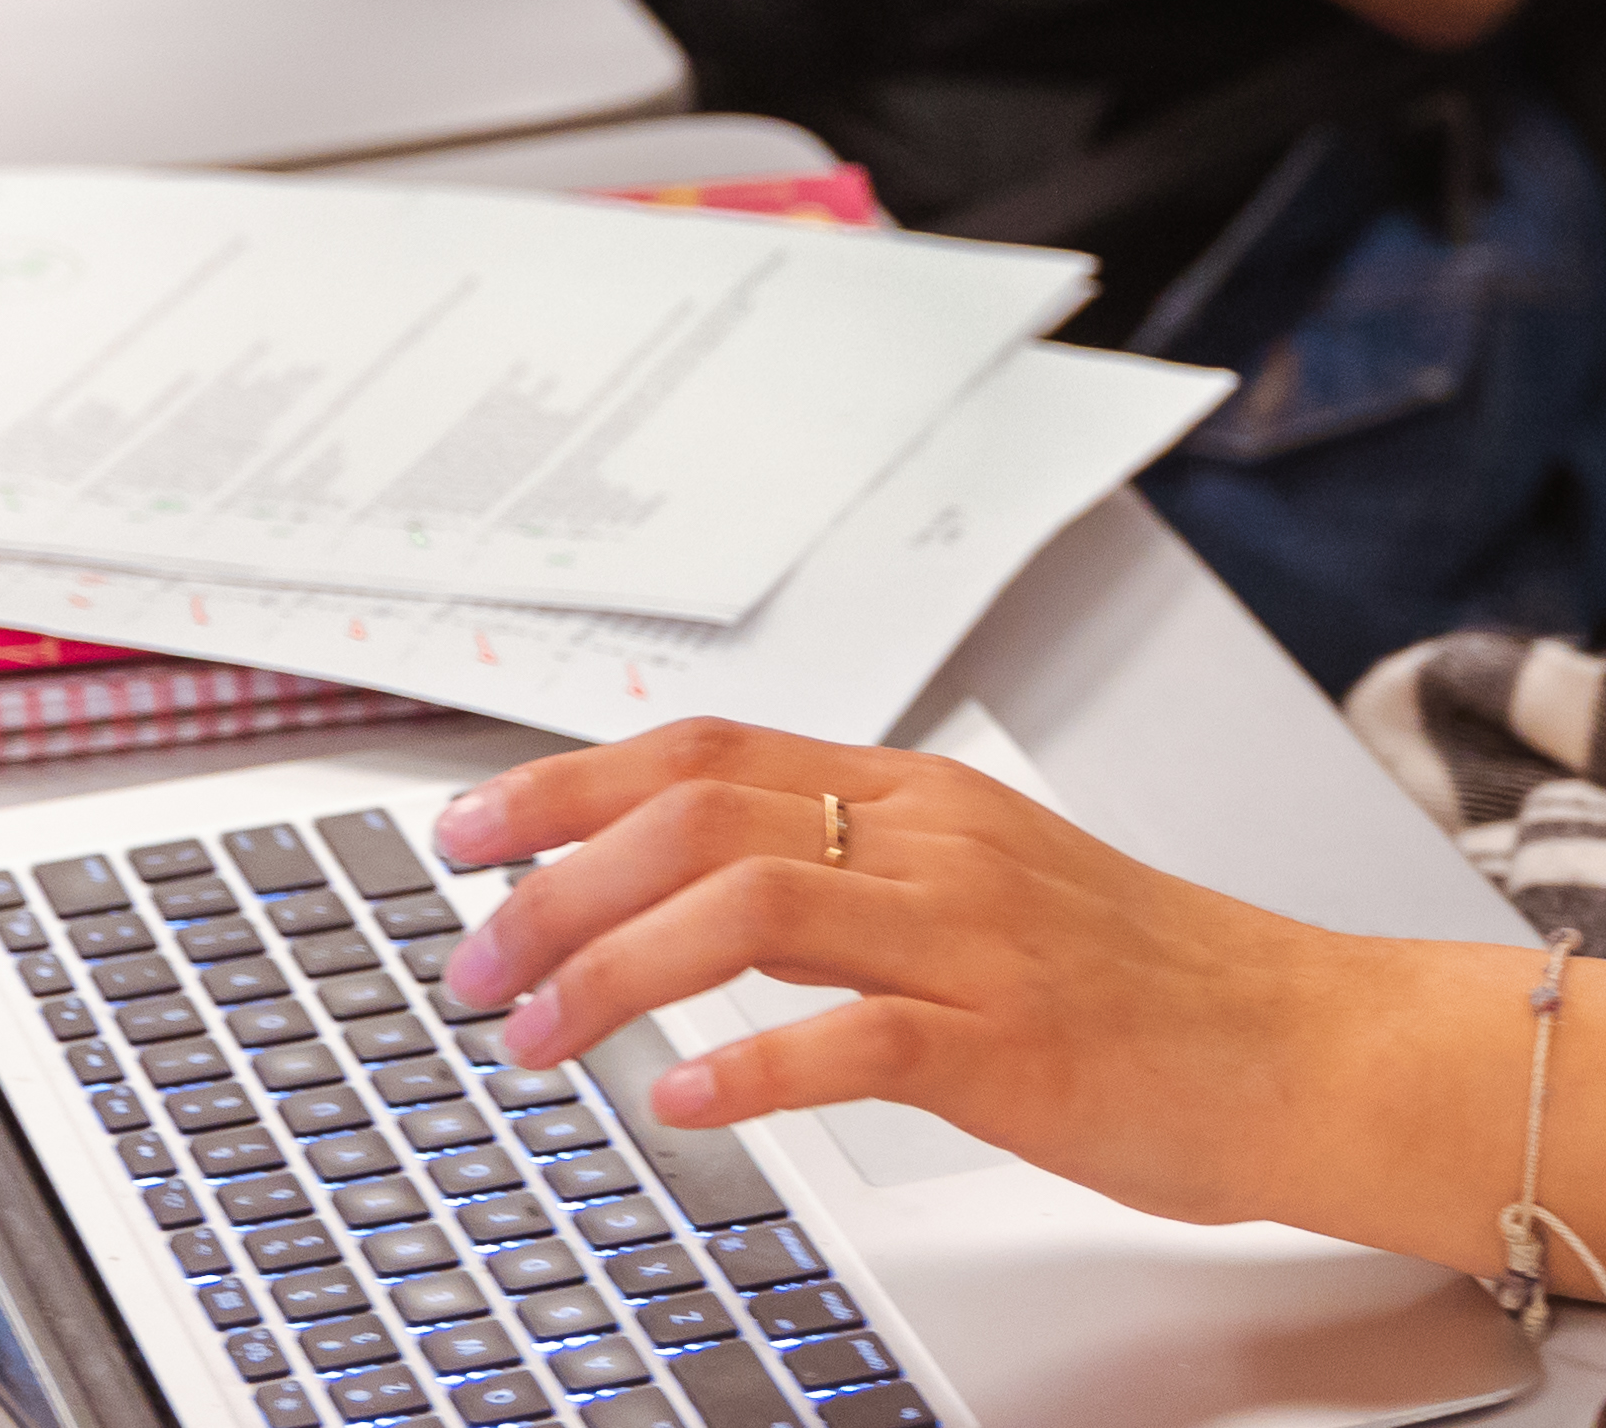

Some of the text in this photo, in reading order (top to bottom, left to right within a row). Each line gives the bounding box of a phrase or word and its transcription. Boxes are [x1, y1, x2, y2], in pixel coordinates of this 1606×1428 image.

[230, 974, 257, 986] P
[374, 1031, 402, 1043] K
[403, 1075, 433, 1083] J
[308, 1102, 341, 1117] U
[237, 1143, 268, 1153] 7
[336, 1151, 364, 1162] Y
[459, 1164, 491, 1177] G
[575, 1170, 606, 1181] V
[267, 1189, 295, 1199] 6
[363, 1195, 394, 1207] T
[488, 1213, 520, 1222] F
[605, 1214, 638, 1228] C
[292, 1236, 324, 1247] 5
[394, 1242, 424, 1255] R
[519, 1258, 552, 1272] D
[639, 1262, 671, 1276] X
[321, 1284, 348, 1293] 4
[423, 1291, 455, 1303] E
[550, 1306, 583, 1319] S
[669, 1311, 704, 1324] Z
[350, 1332, 381, 1344] 3
[452, 1339, 487, 1355] W
[583, 1356, 616, 1369] A
[379, 1382, 411, 1395] 2
[483, 1388, 516, 1404] Q
